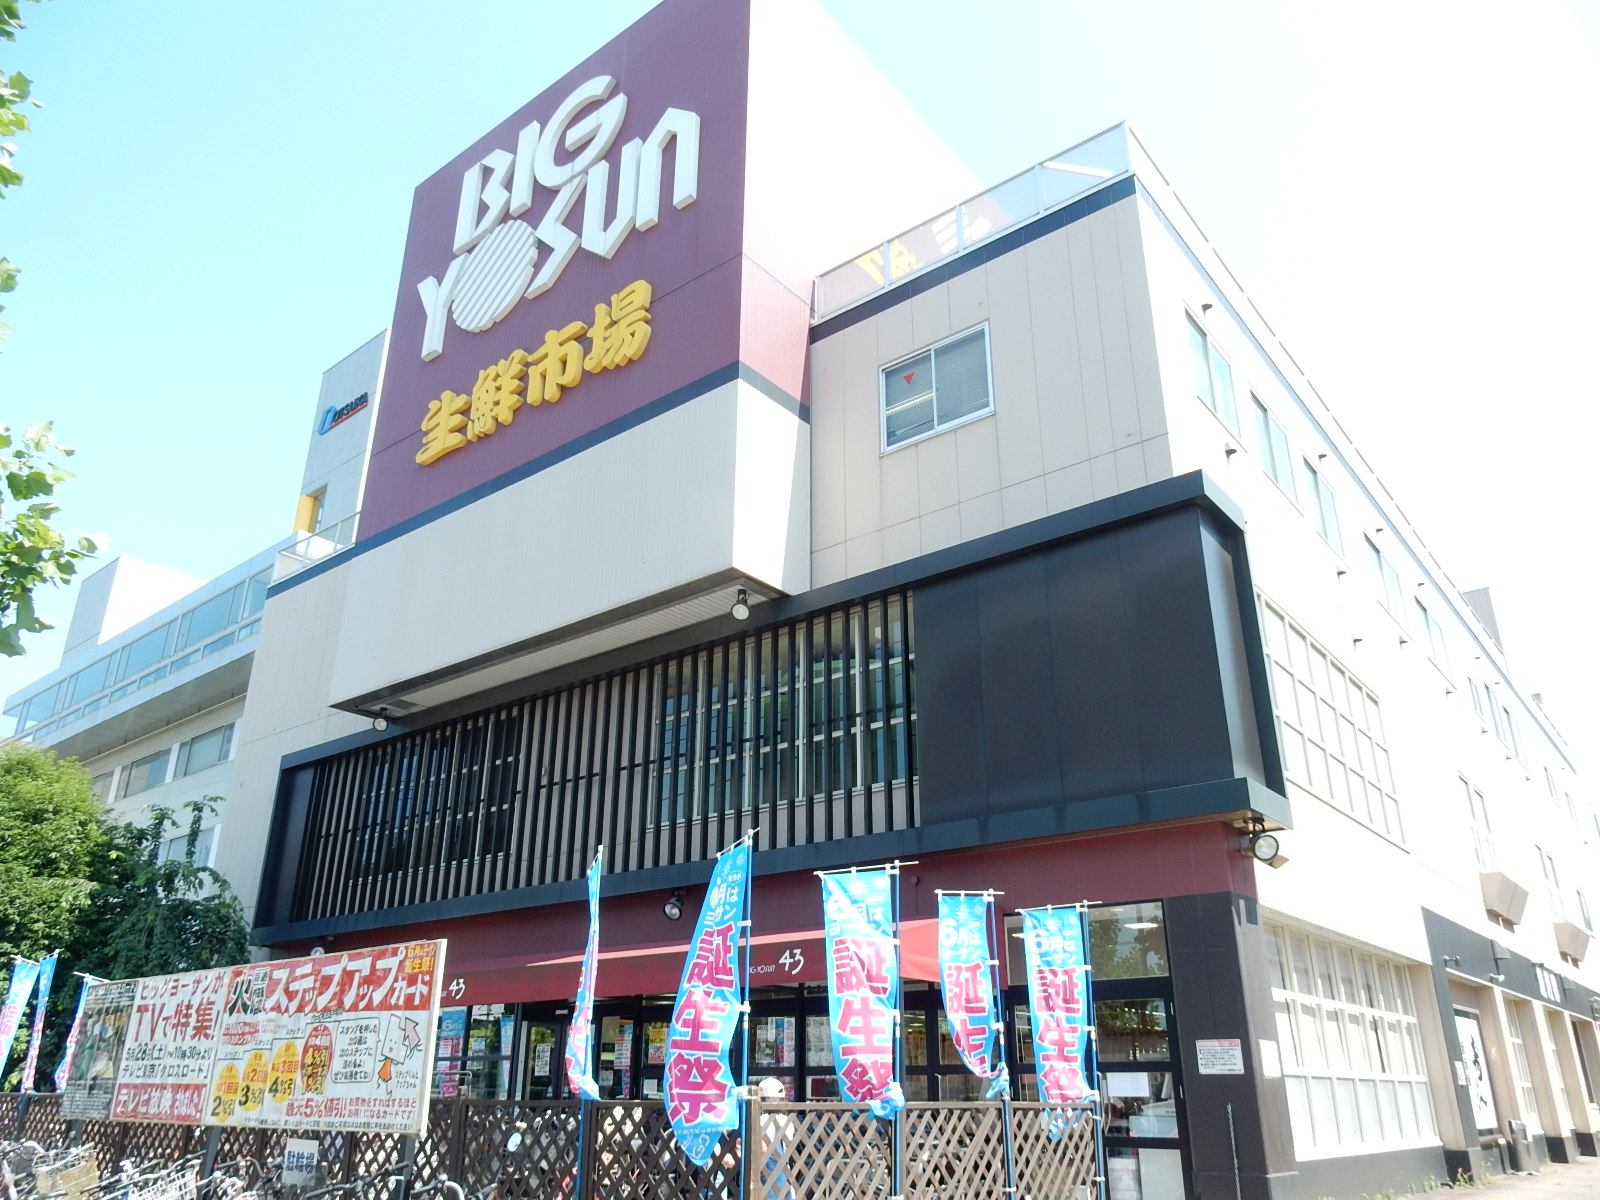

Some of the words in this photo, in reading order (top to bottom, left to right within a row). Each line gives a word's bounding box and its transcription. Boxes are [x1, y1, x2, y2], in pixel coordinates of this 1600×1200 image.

[453, 74, 628, 255] BIG
[416, 107, 700, 362] YOSUN
[415, 280, 652, 465] 生鮮市場
[1028, 929, 1078, 953] 6月は
[779, 948, 805, 975] 43
[140, 971, 225, 1000] ビッグヨーサンが
[449, 978, 466, 1000] 43
[667, 921, 735, 1126] 誕生祭
[285, 1150, 316, 1174] 駐輪場
